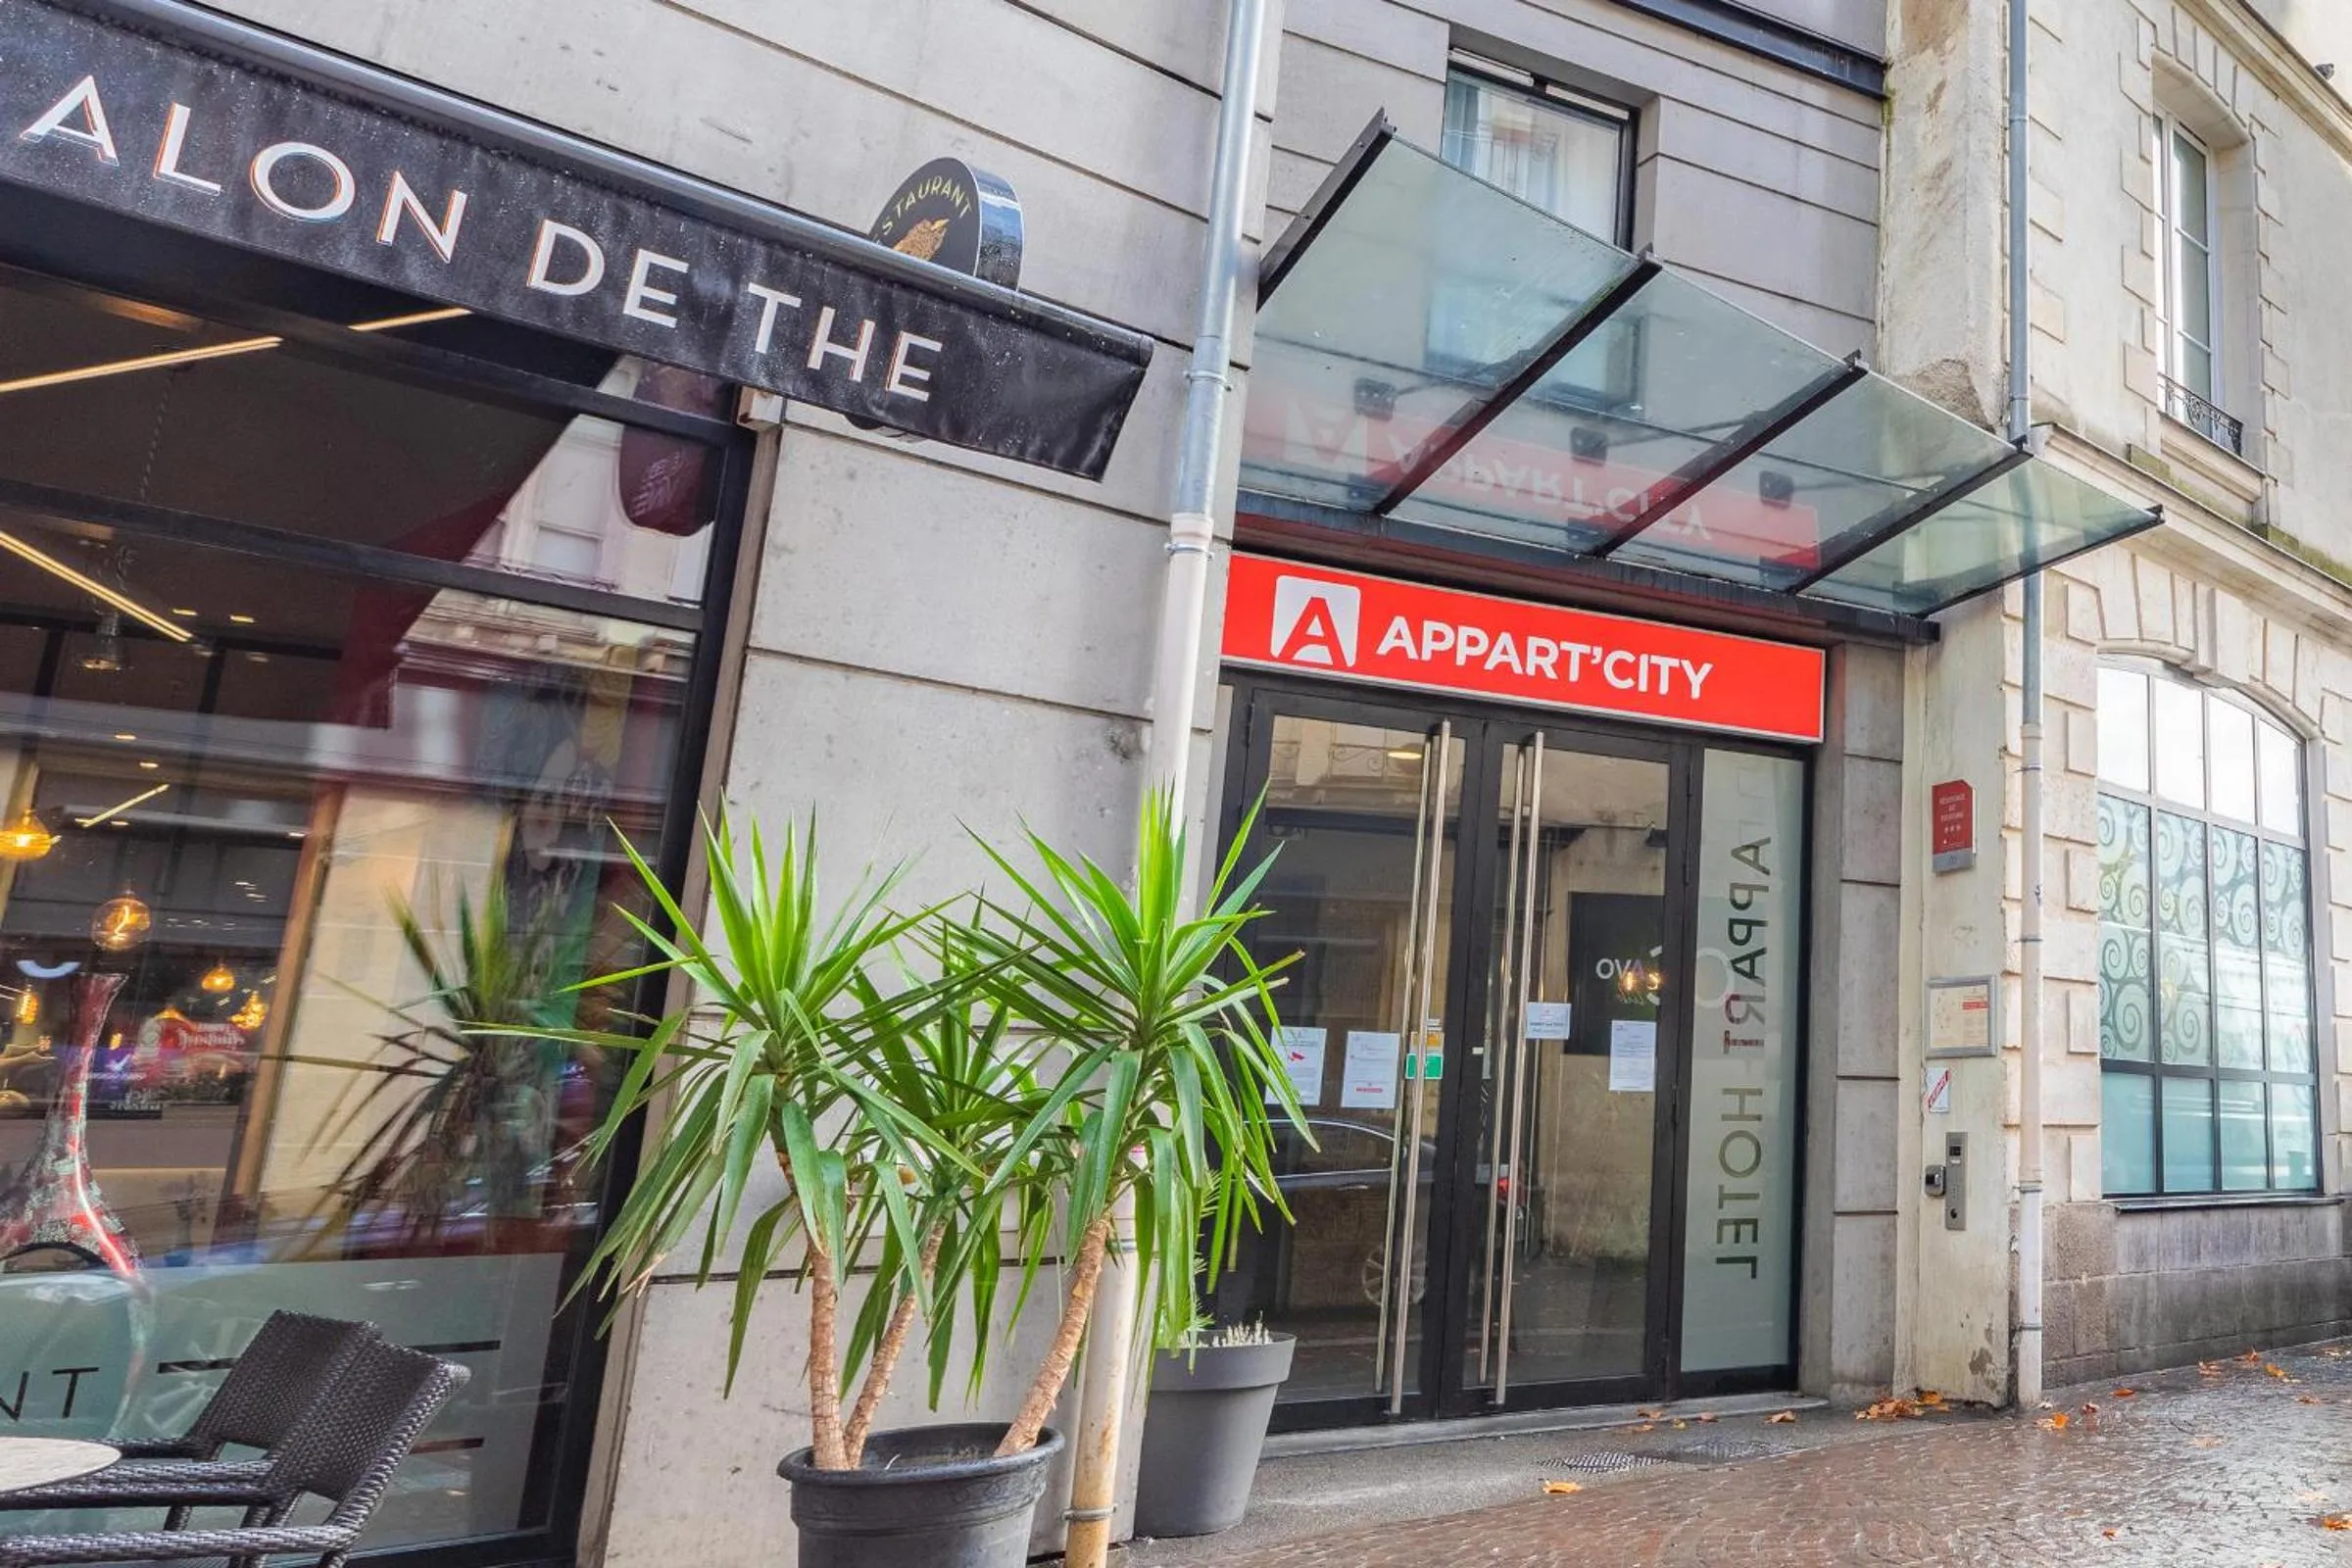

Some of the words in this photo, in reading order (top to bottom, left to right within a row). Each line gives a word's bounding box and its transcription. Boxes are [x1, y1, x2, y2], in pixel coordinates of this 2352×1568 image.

[20, 74, 468, 264] ALON
[527, 219, 689, 329] DE
[748, 281, 943, 403] THE
[1376, 615, 1714, 700] APPART'CITY
